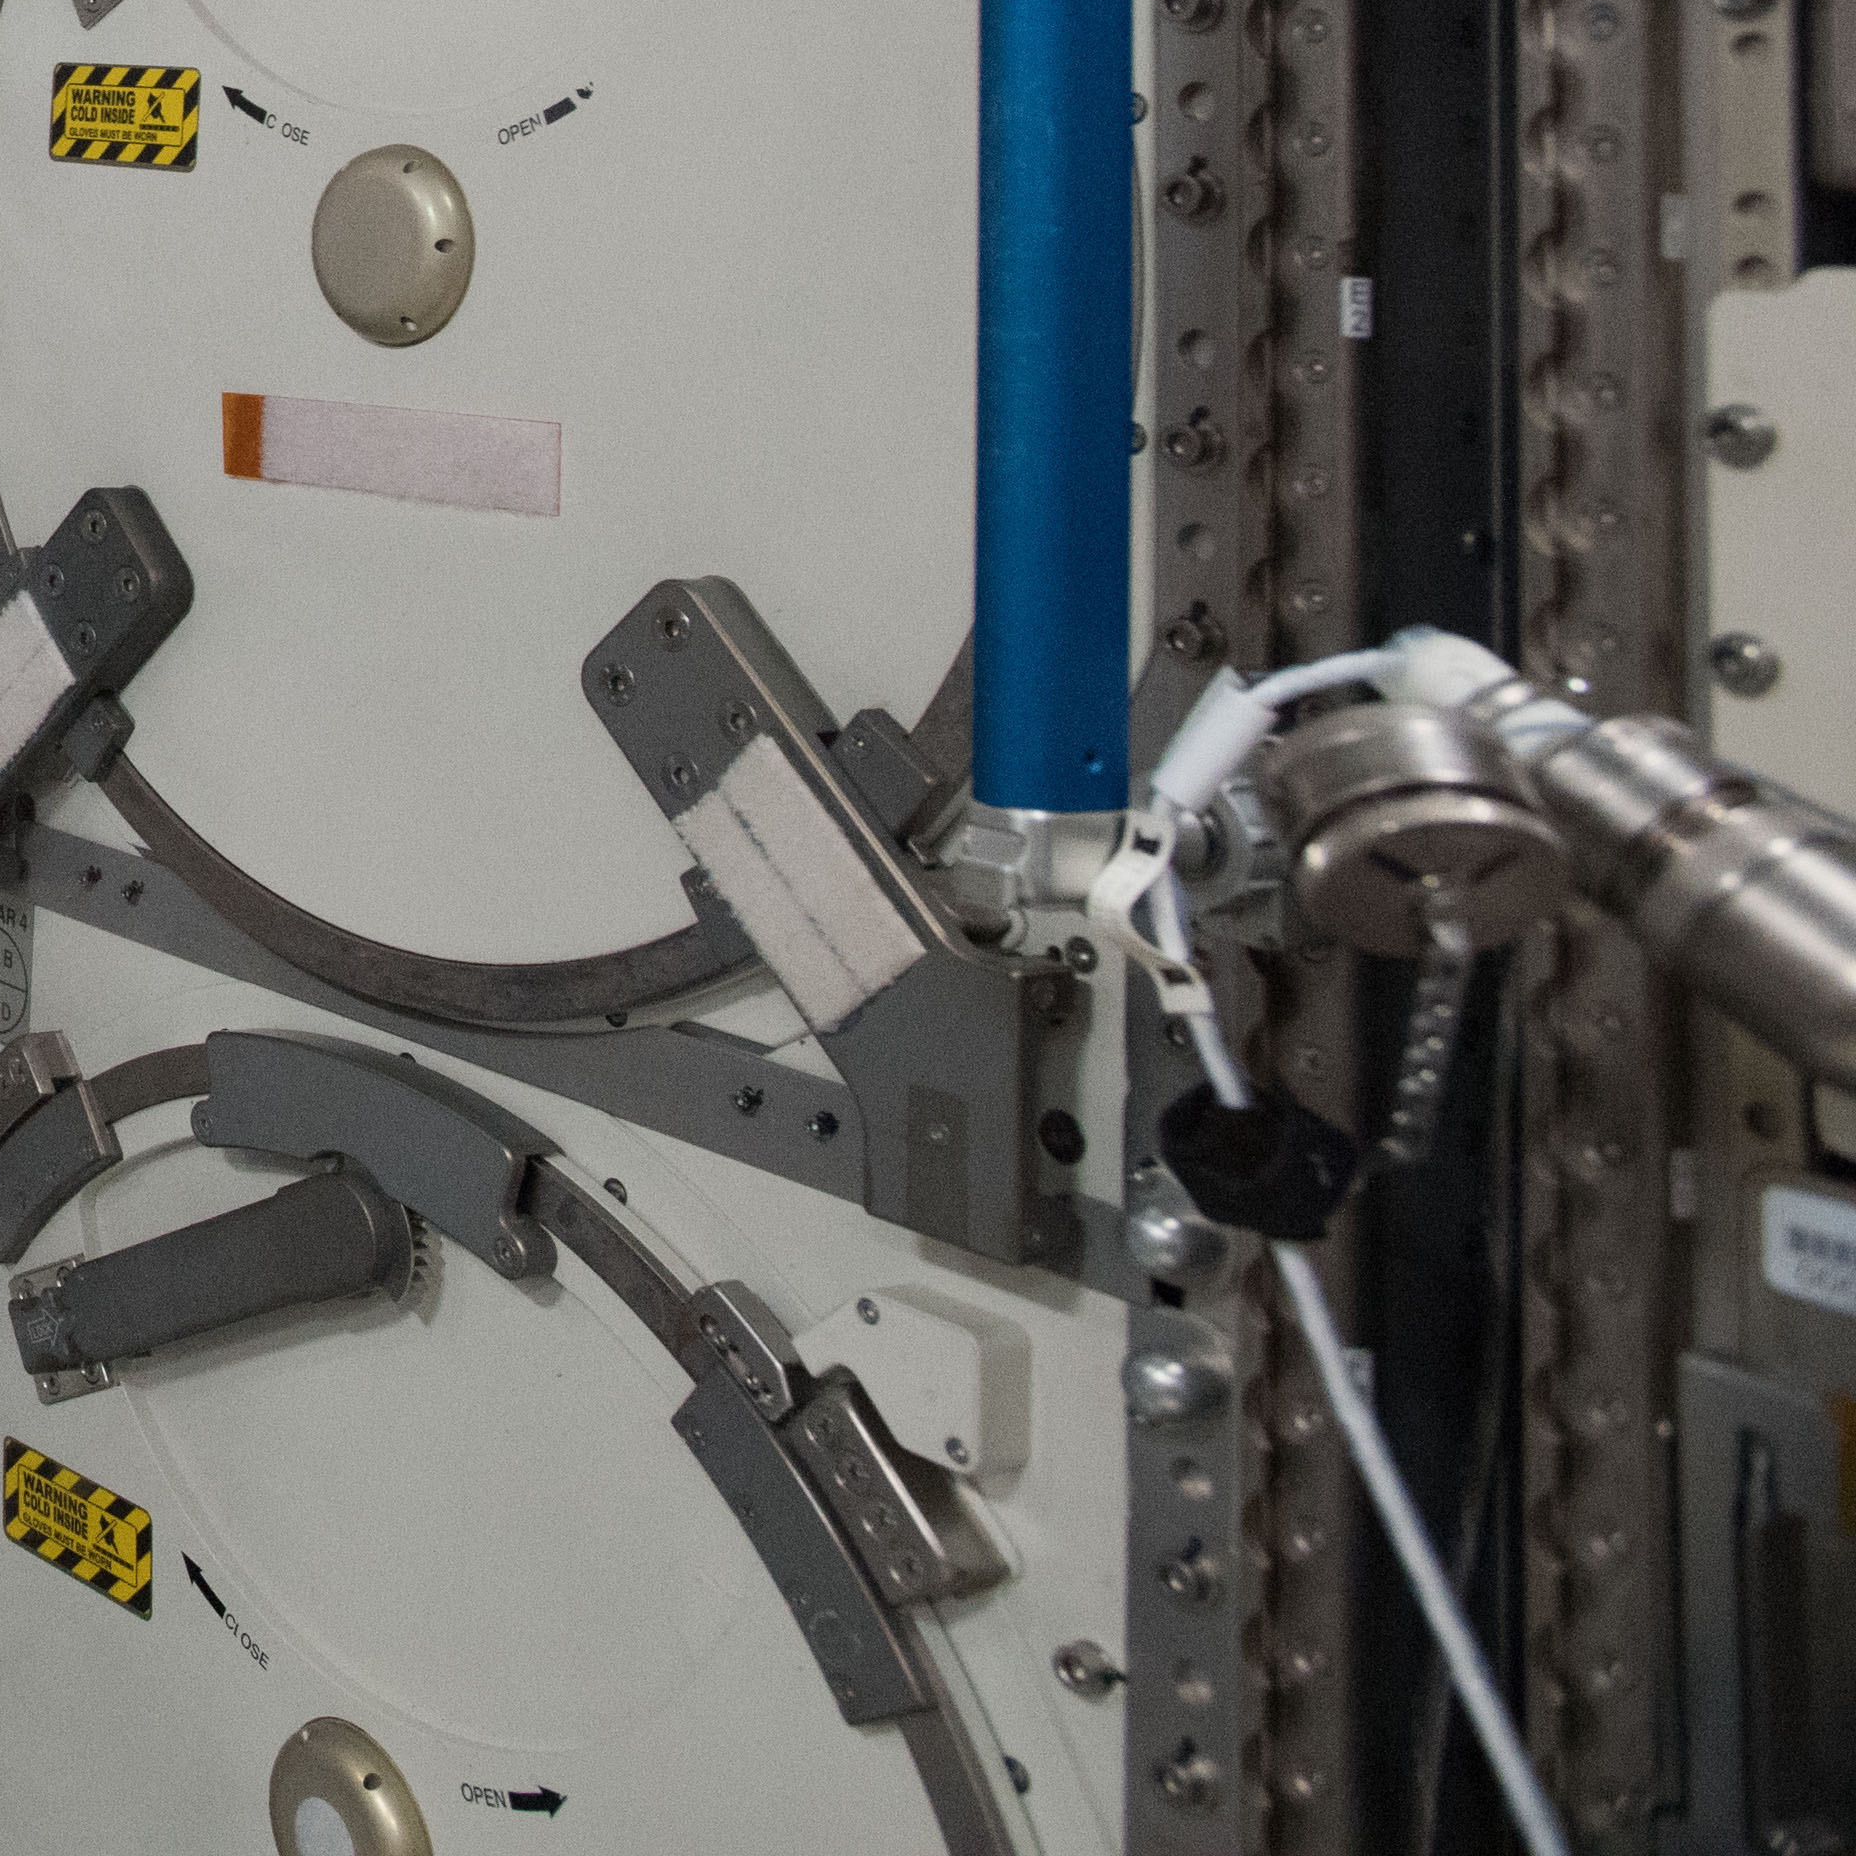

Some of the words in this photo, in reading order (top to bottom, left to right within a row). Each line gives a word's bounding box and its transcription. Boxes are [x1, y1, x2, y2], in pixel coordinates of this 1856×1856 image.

[72, 89, 136, 107] WARNING
[71, 106, 98, 122] COLD
[100, 109, 136, 124] INSIDE
[497, 112, 544, 145] OPEN
[69, 126, 99, 138] GLOVES
[100, 128, 120, 139] MUST
[122, 130, 132, 141] BE
[134, 131, 158, 142] WORN
[265, 113, 311, 145] COSE
[19, 913, 28, 933] 4
[4, 948, 13, 969] B
[1, 1001, 11, 1022] D
[23, 1471, 88, 1519] WARNING
[23, 1491, 51, 1518] COLD
[53, 1506, 88, 1540] INSIDE
[23, 1511, 53, 1537] GLOVES
[54, 1526, 74, 1546] MUST
[76, 1537, 87, 1553] BE
[88, 1543, 112, 1571] WORN
[225, 1612, 269, 1671] CLOSE
[461, 1782, 507, 1809] OPEN
